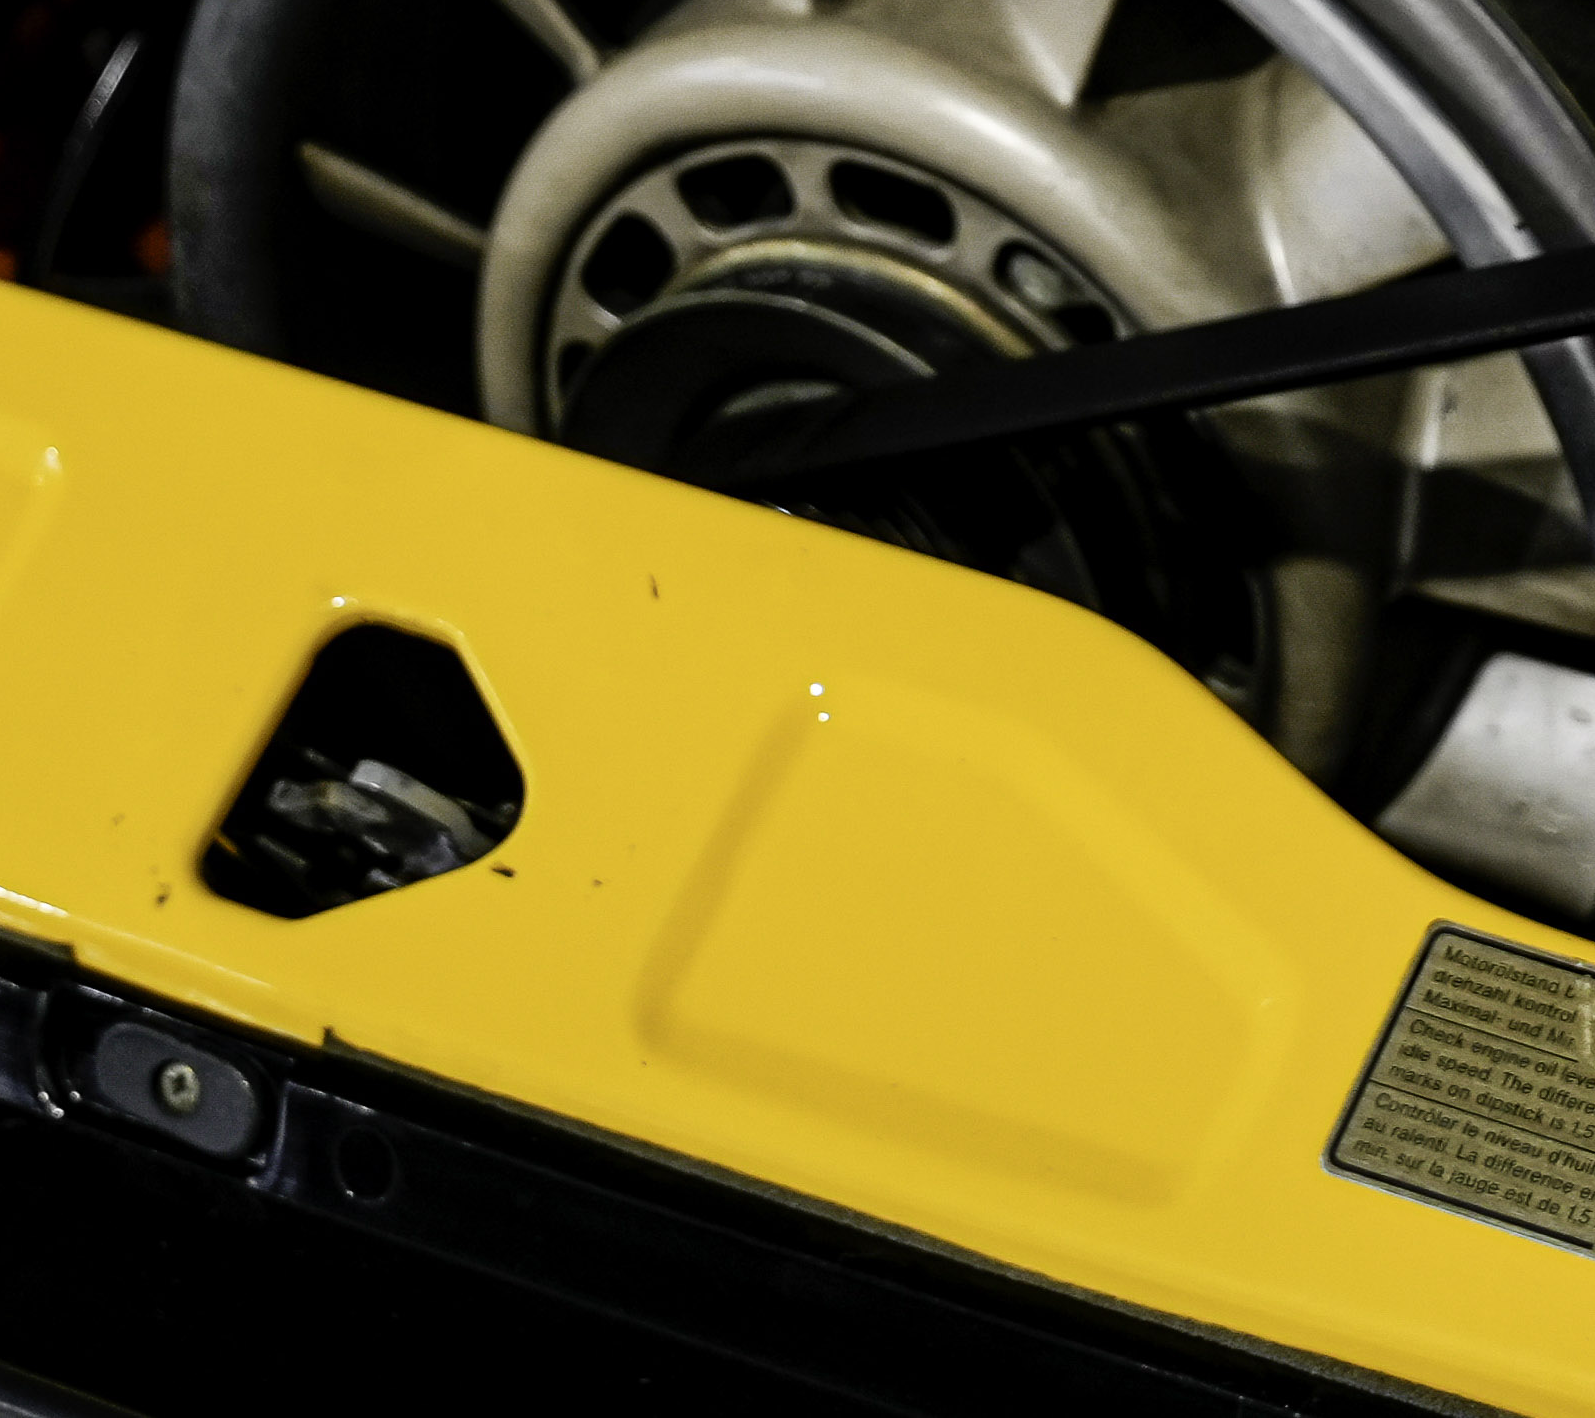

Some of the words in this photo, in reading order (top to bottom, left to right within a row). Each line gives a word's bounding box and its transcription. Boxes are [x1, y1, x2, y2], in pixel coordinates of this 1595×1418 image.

[1431, 968, 1511, 1004] drehzahl
[1421, 988, 1505, 1026] Maximal-
[1506, 1014, 1546, 1039] und
[1406, 1017, 1468, 1049] Check
[1467, 1040, 1531, 1072] engine
[1532, 1057, 1559, 1077] oil
[1386, 1063, 1443, 1092] marks
[1445, 1083, 1471, 1101] on
[1472, 1089, 1547, 1126] dipstick
[1547, 1113, 1568, 1131] is
[1498, 1071, 1536, 1095] The
[1360, 1114, 1389, 1135] au
[1453, 1143, 1481, 1165] La
[1460, 1120, 1482, 1139] le
[1482, 1126, 1546, 1159] niveau
[1393, 1152, 1425, 1172] sur
[1426, 1160, 1448, 1179] la
[1446, 1167, 1503, 1199] jauge
[1501, 1185, 1534, 1207] est
[1534, 1195, 1563, 1216] de
